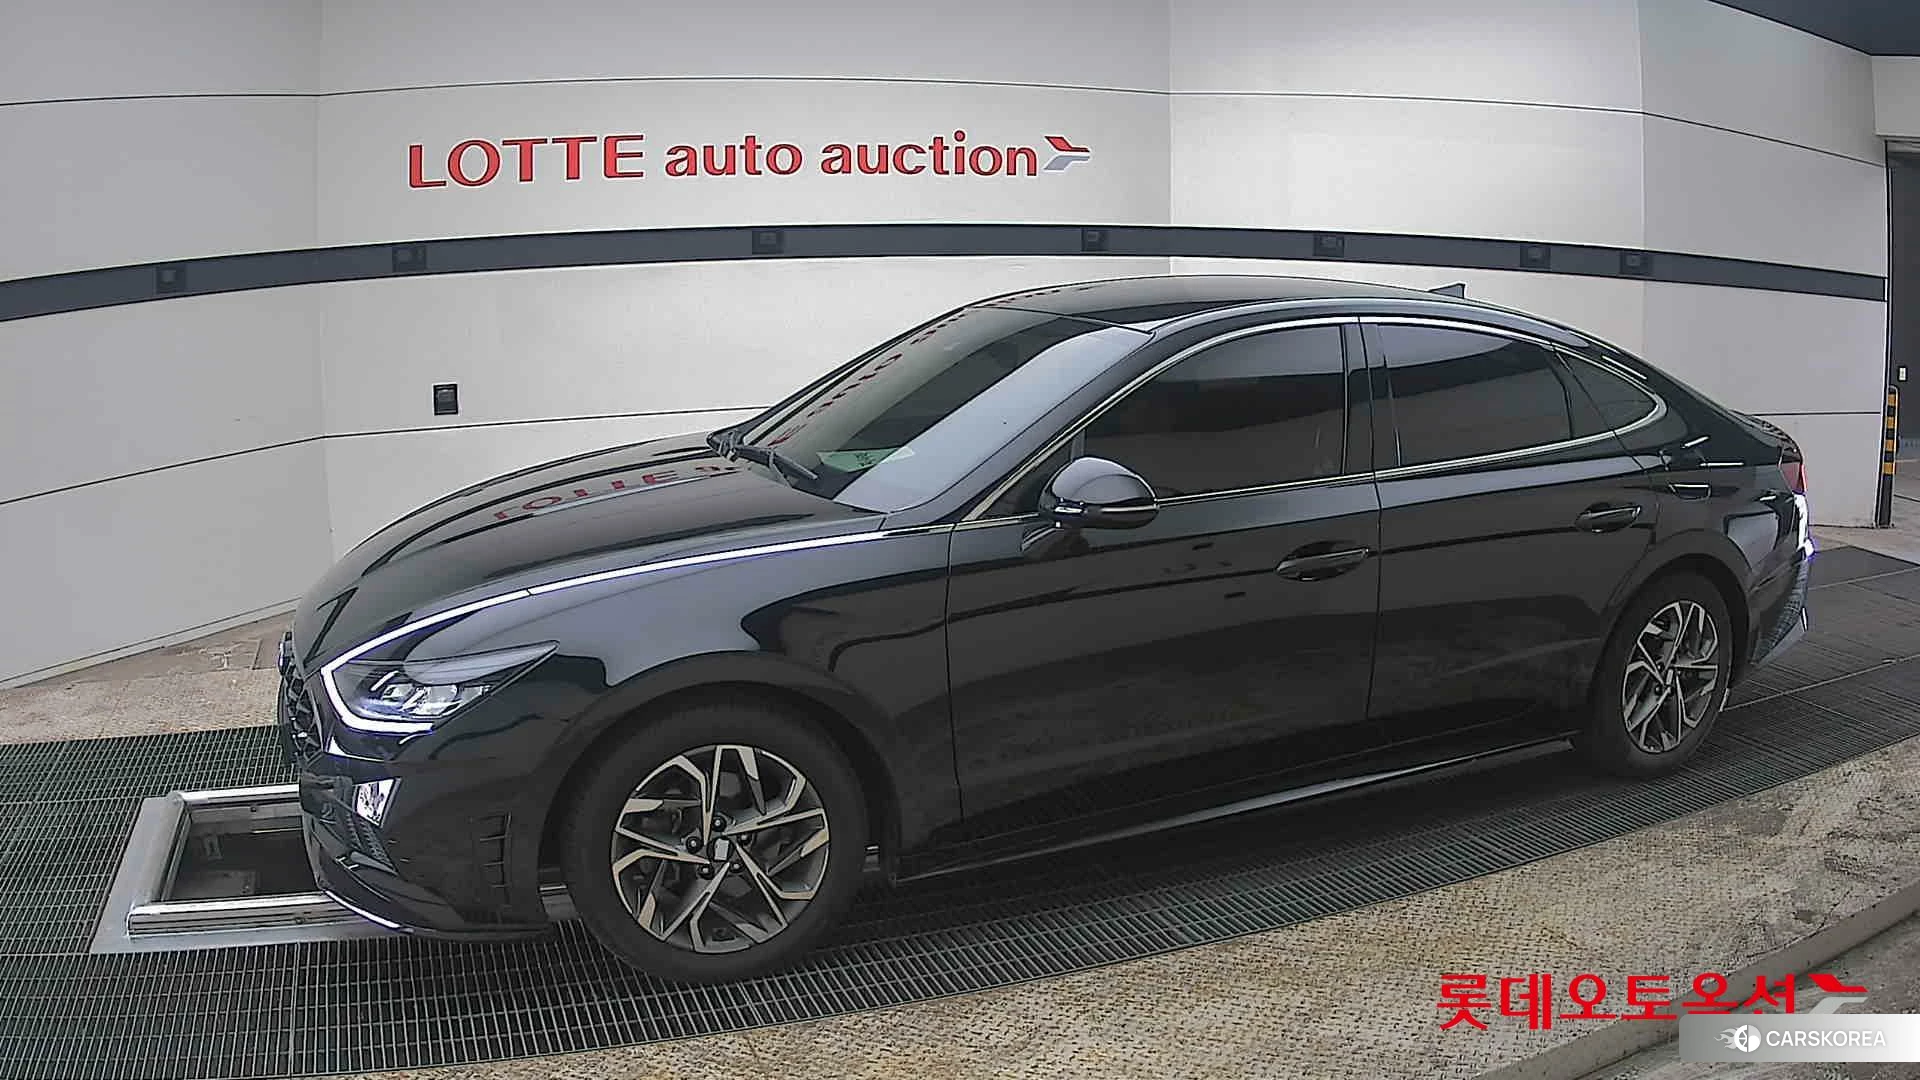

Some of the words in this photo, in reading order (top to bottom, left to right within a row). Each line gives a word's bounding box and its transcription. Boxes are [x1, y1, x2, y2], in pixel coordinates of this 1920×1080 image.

[408, 134, 645, 188] LOTTE
[664, 135, 803, 177] auto
[820, 130, 1038, 176] auction
